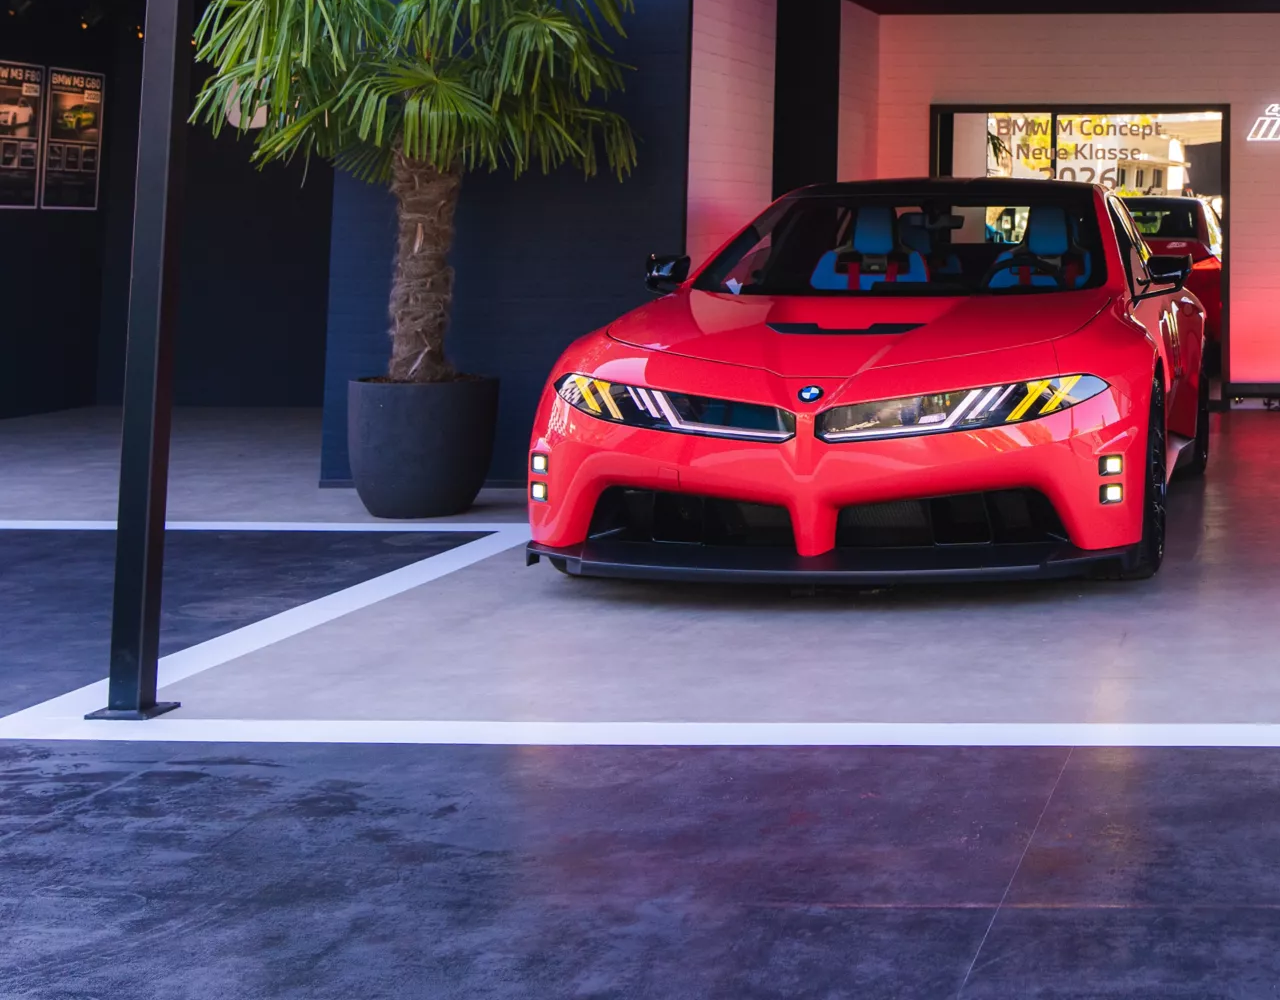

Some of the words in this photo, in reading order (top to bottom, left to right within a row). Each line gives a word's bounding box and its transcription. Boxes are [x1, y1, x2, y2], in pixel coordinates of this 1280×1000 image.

[52, 72, 72, 86] BMW
[996, 119, 1050, 136] BMW
[1056, 119, 1073, 136] M
[1080, 119, 1162, 140] Concept
[1016, 143, 1070, 160] Neue
[1074, 143, 1142, 160] Klasse
